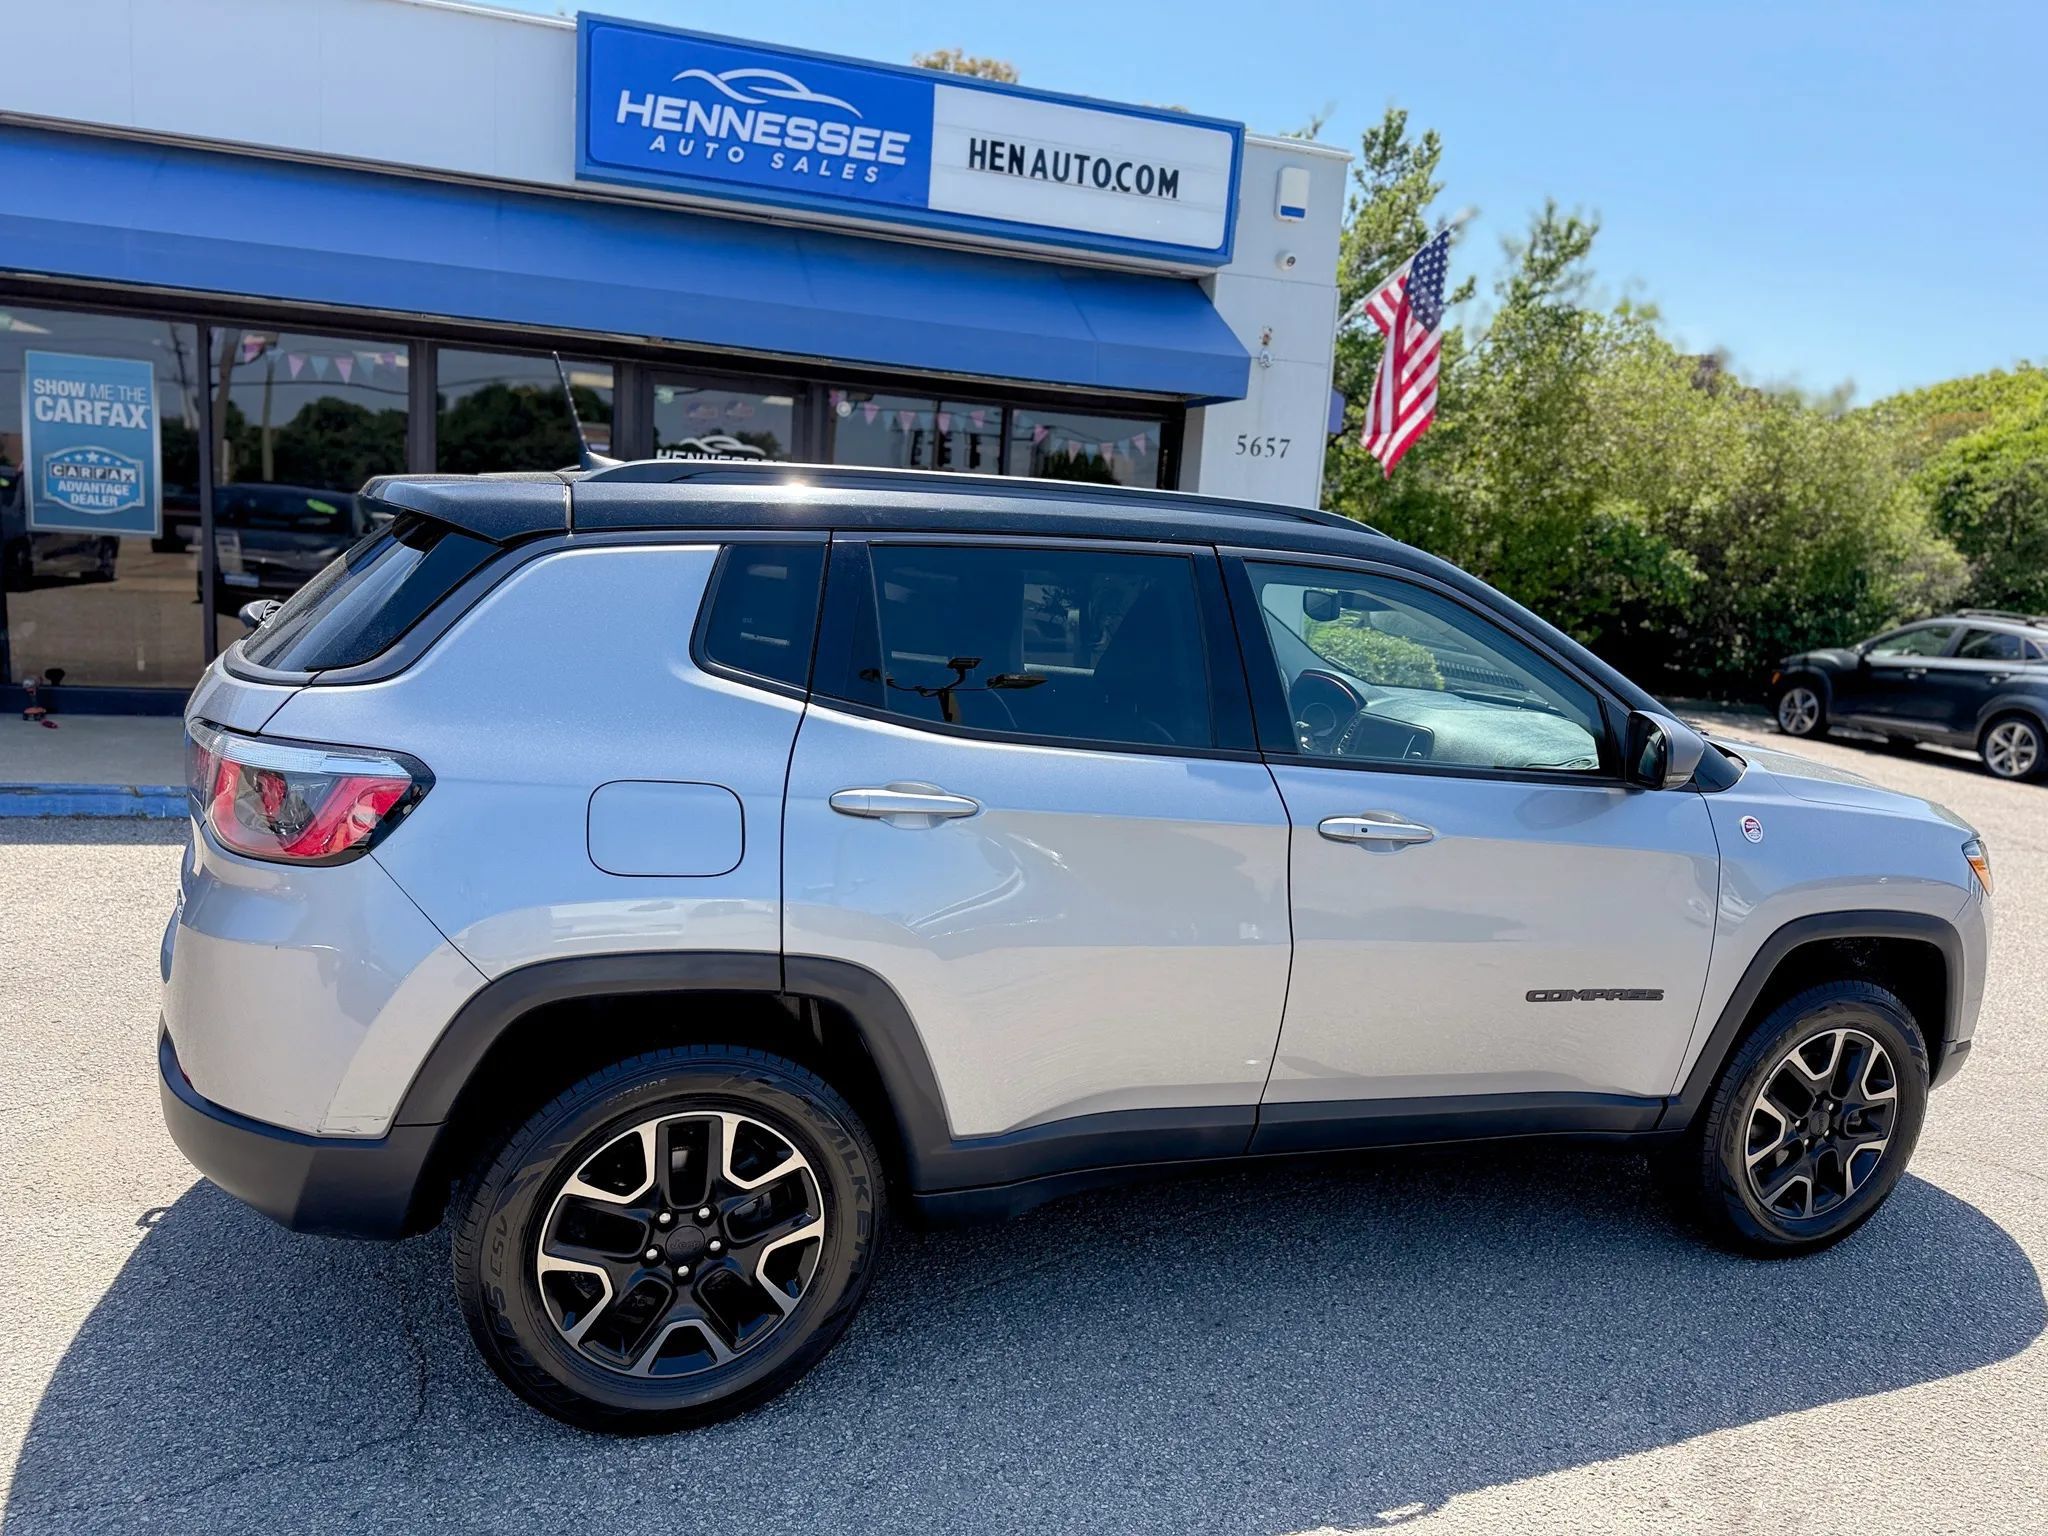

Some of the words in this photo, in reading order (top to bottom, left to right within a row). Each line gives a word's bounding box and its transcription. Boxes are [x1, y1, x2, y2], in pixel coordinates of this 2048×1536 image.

[616, 90, 911, 166] HENNESSEE
[650, 135, 745, 163] AUTO
[771, 153, 878, 183] SALES
[969, 138, 1180, 198] HENAUTO.COM
[34, 378, 86, 397] SHOW
[91, 384, 114, 400] ME
[118, 385, 146, 403] THE
[35, 395, 148, 429] CARFAX
[1235, 433, 1291, 459] 5657
[54, 465, 135, 481] CARFAX
[58, 480, 129, 496] ADVANTAGE
[70, 493, 118, 507] DEALER
[1525, 988, 1665, 1002] COMPASS
